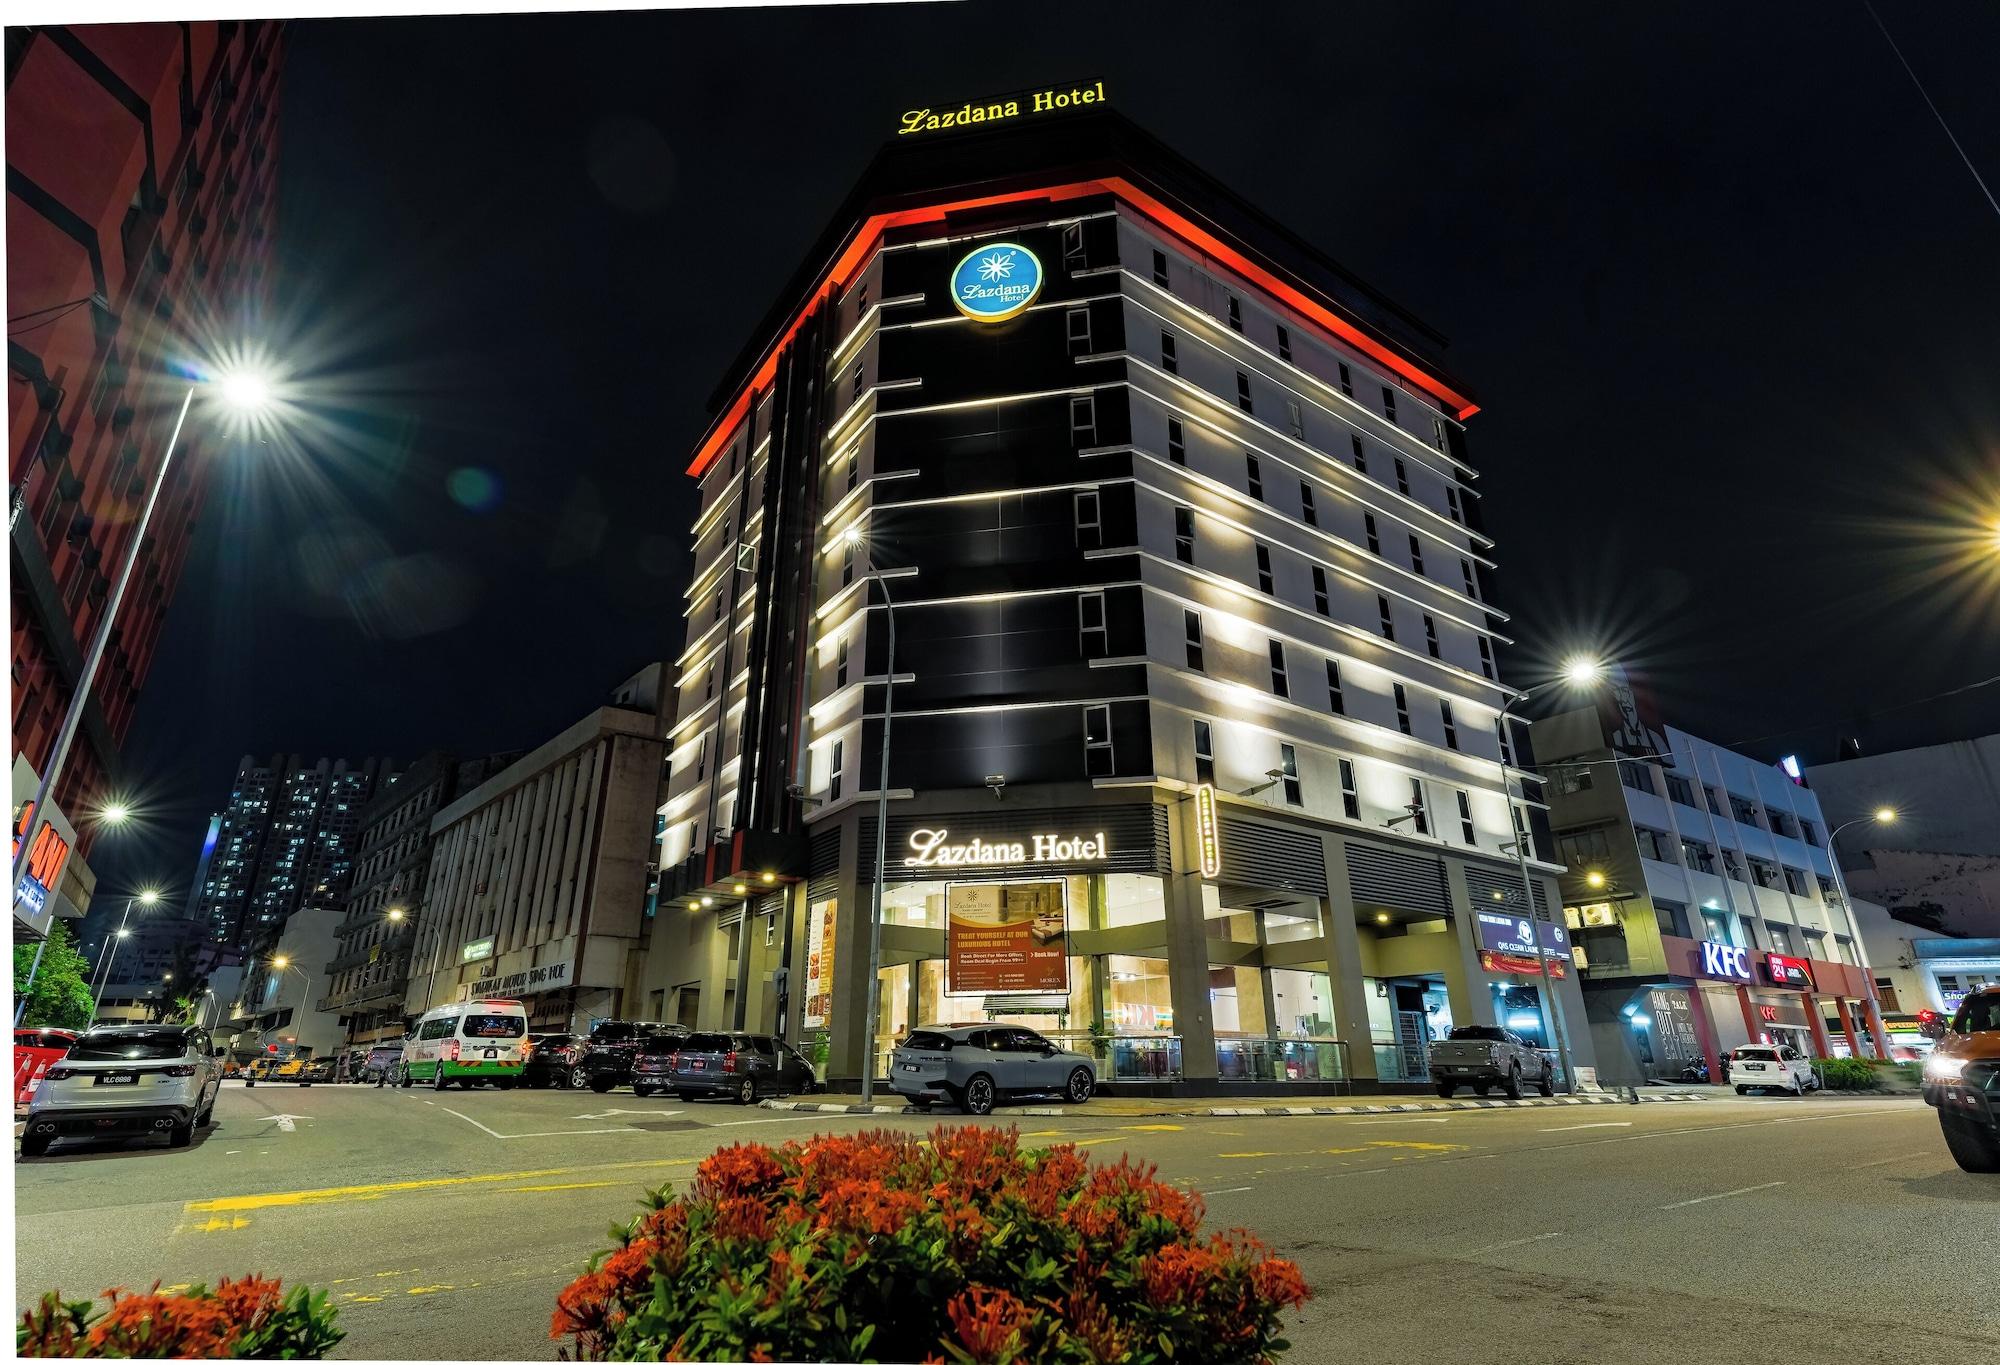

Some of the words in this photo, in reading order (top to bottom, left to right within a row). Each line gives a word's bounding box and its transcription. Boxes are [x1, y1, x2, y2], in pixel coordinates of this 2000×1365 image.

[898, 101, 1019, 134] Lazdana
[1032, 82, 1106, 113] Hotel
[961, 282, 1030, 300] Lazdana
[1000, 293, 1024, 303] Hotel
[904, 829, 1026, 868] Lazdana
[1031, 832, 1108, 862] Hotel
[957, 932, 975, 940] TREAT
[976, 931, 1006, 939] YOURSELF
[1015, 930, 1029, 938] OUR
[992, 939, 1011, 947] HOTEL
[1703, 941, 1751, 979] KFC
[528, 967, 546, 985] SING
[549, 963, 566, 981] HOE
[1773, 965, 1786, 978] 24
[1760, 1006, 1777, 1020] KFC
[1656, 1010, 1675, 1035] OUT
